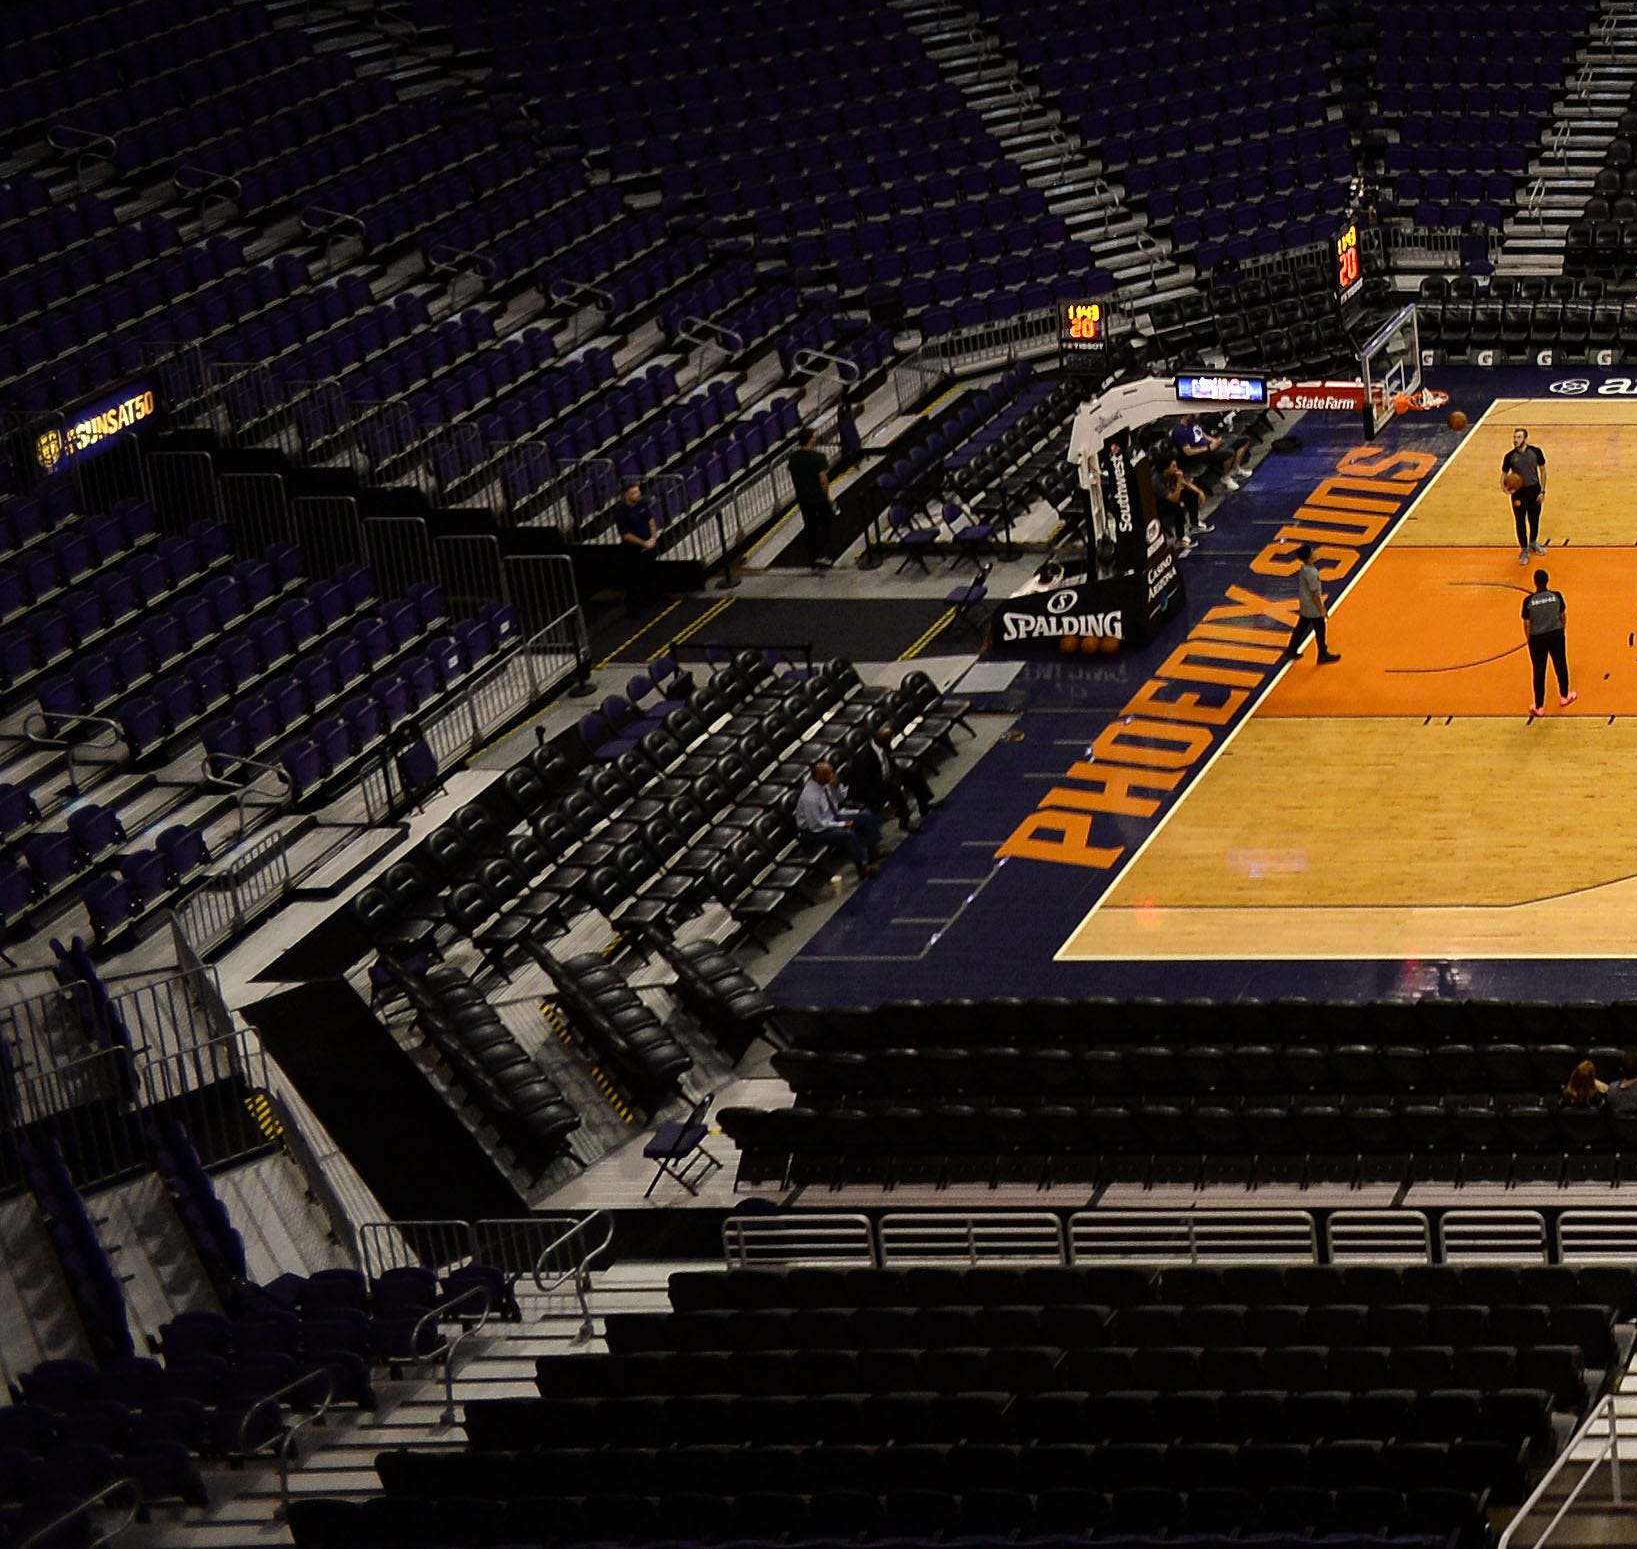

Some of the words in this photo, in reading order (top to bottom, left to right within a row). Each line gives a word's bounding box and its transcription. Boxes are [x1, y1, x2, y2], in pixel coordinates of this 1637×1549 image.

[1340, 246, 1358, 287] 20
[65, 390, 154, 456] #SUNSAT50
[1294, 396, 1355, 411] StateFarm
[1111, 453, 1132, 532] Southwest
[1250, 446, 1439, 583] SUNS
[1148, 554, 1172, 585] CASINO
[1149, 566, 1177, 602] ARIZONA
[1003, 609, 1124, 641] SPALDING
[994, 584, 1301, 870] PHOENIX
